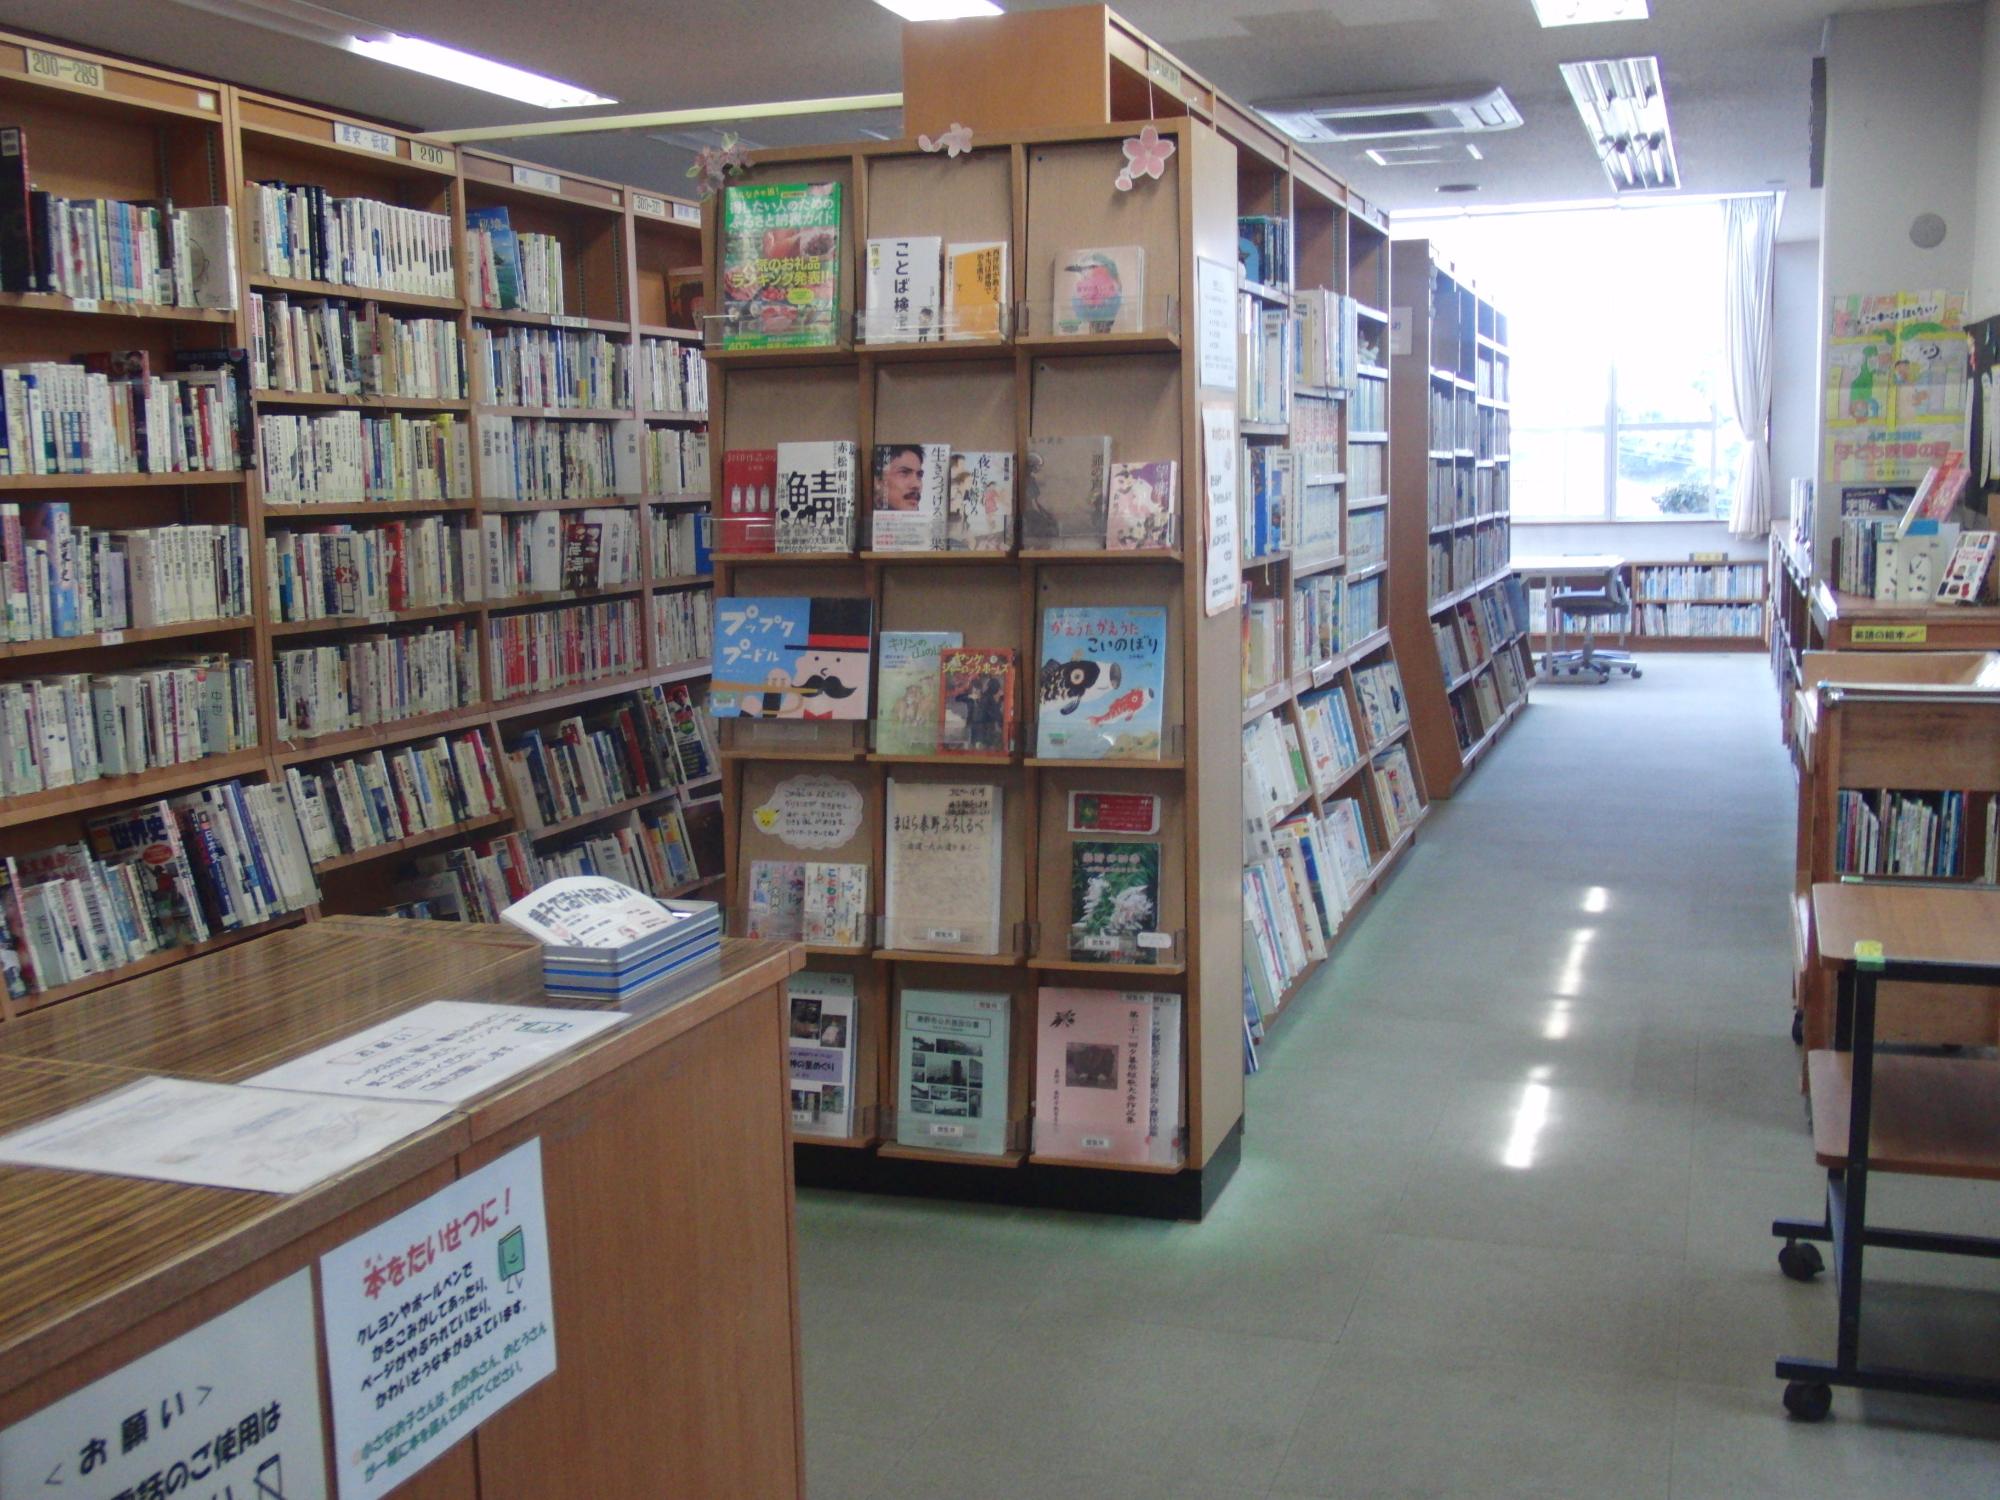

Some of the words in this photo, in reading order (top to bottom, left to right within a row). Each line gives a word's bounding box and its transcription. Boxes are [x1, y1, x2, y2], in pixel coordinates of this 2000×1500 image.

[421, 146, 444, 165] 290
[837, 442, 848, 495] 赤松利市
[786, 470, 838, 524] 鯖
[722, 639, 780, 665] プードル
[1087, 636, 1158, 654] こいのぼり
[362, 1187, 512, 1300] 本をたいせつに!
[356, 1261, 473, 1346] クレヨンやボールペンで
